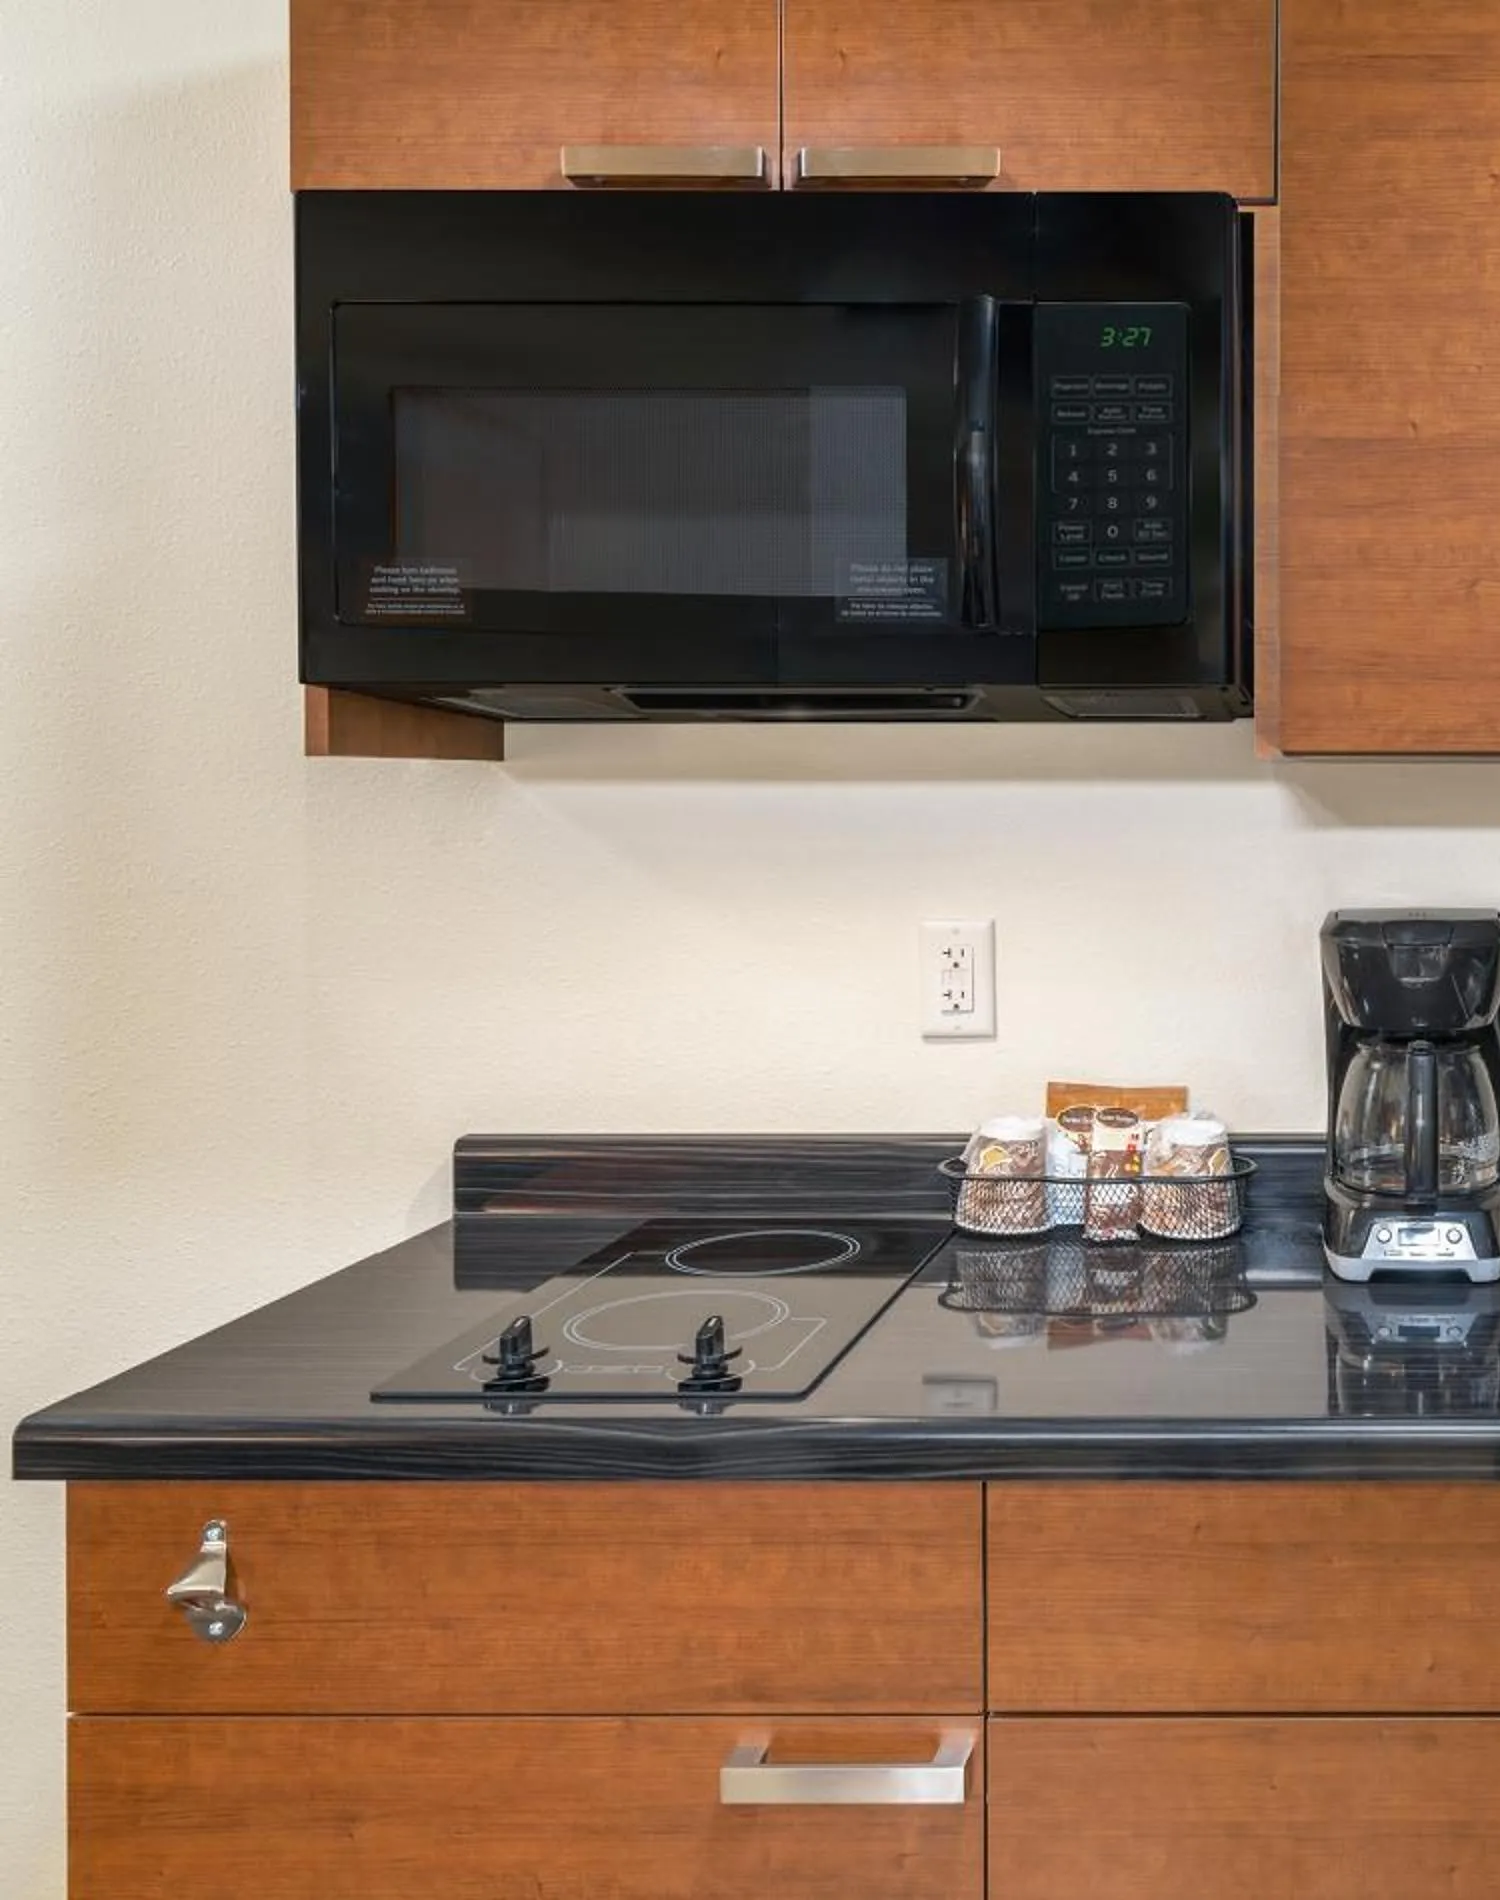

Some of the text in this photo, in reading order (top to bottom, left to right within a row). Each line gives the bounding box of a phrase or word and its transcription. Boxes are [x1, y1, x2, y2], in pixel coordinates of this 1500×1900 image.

[1100, 326, 1152, 347] 3:27
[1069, 444, 1077, 457] 1
[1107, 442, 1118, 456] 2
[1146, 442, 1157, 455] 3
[1068, 471, 1079, 482] 4
[1107, 469, 1118, 482] 5
[1146, 468, 1157, 481] 6
[1068, 497, 1078, 510] 7
[1107, 497, 1118, 509] 8
[1146, 495, 1157, 508] 9
[1107, 525, 1119, 538] 0
